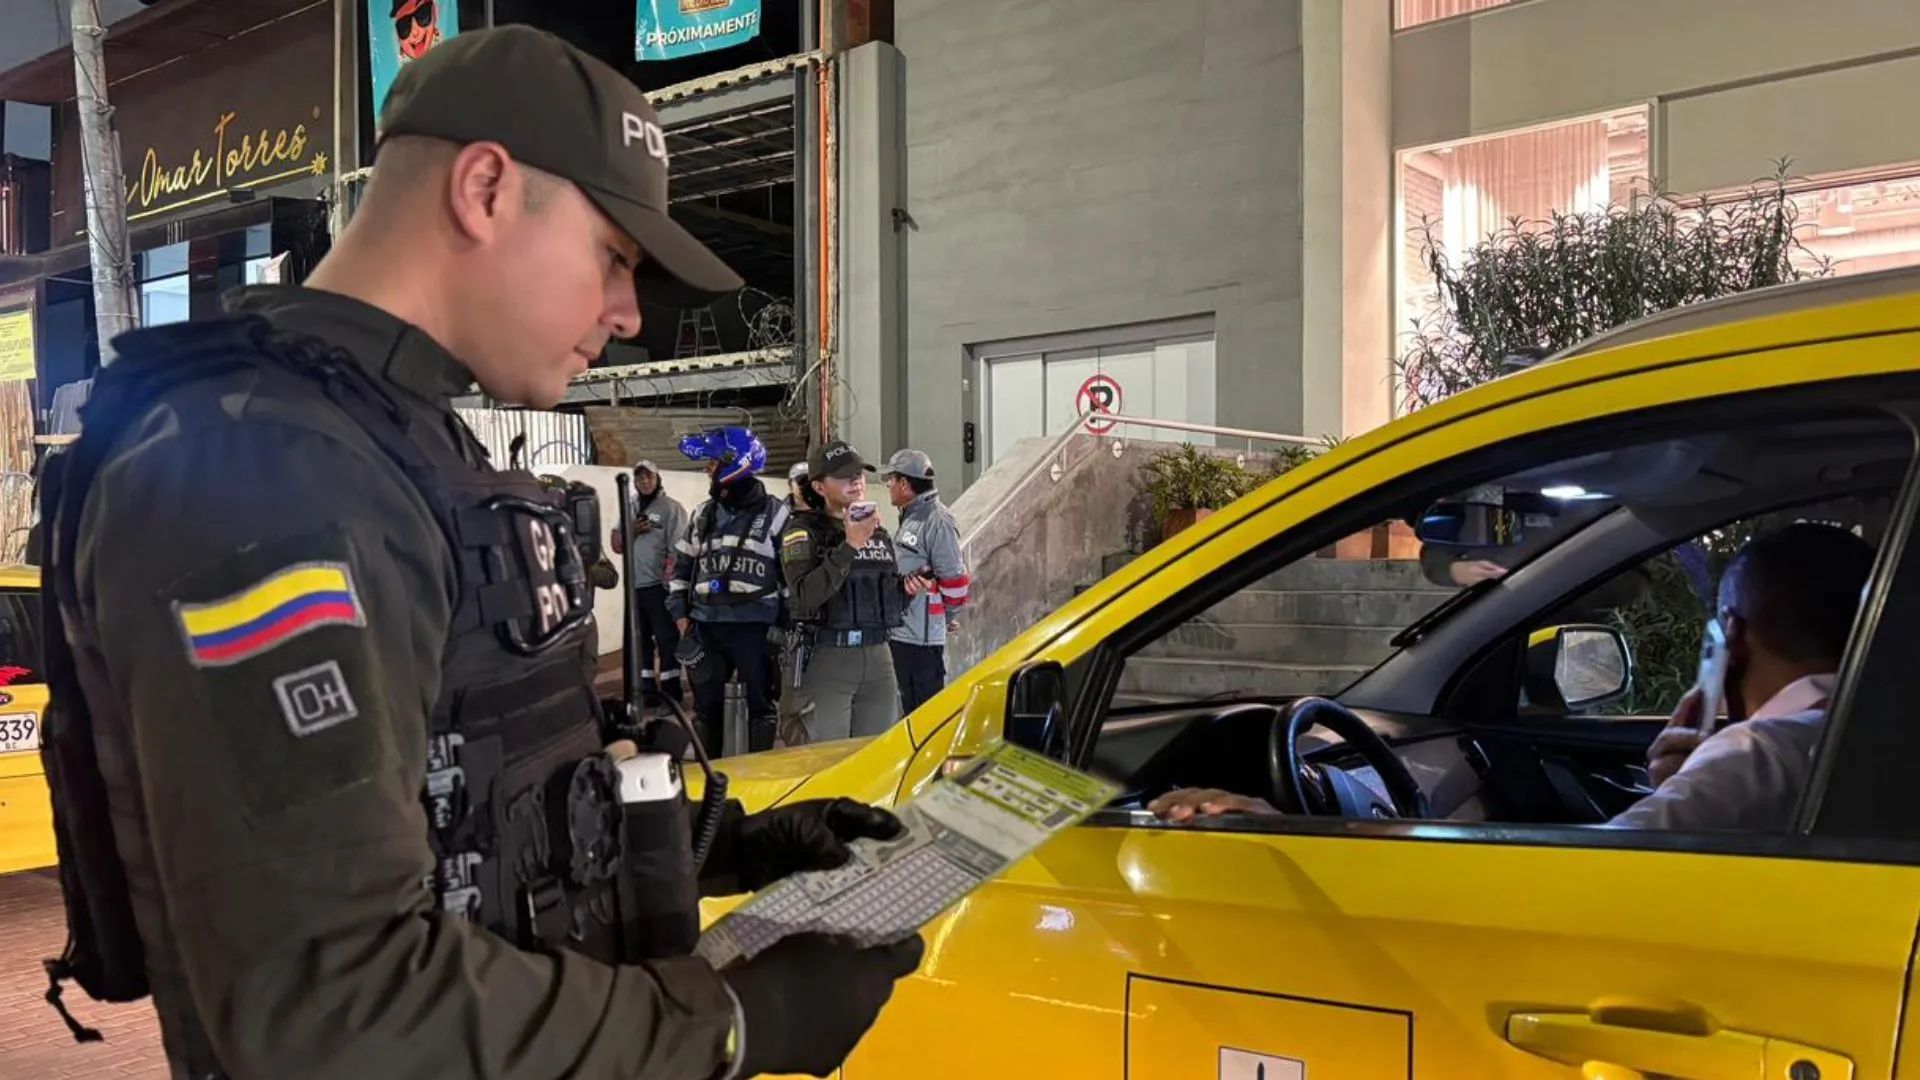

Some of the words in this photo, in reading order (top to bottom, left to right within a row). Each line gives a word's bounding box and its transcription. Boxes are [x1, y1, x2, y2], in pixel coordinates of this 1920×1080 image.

[646, 9, 758, 46] PRÓXIMAMENTE
[140, 147, 213, 208] Omar
[214, 111, 307, 188] Torres
